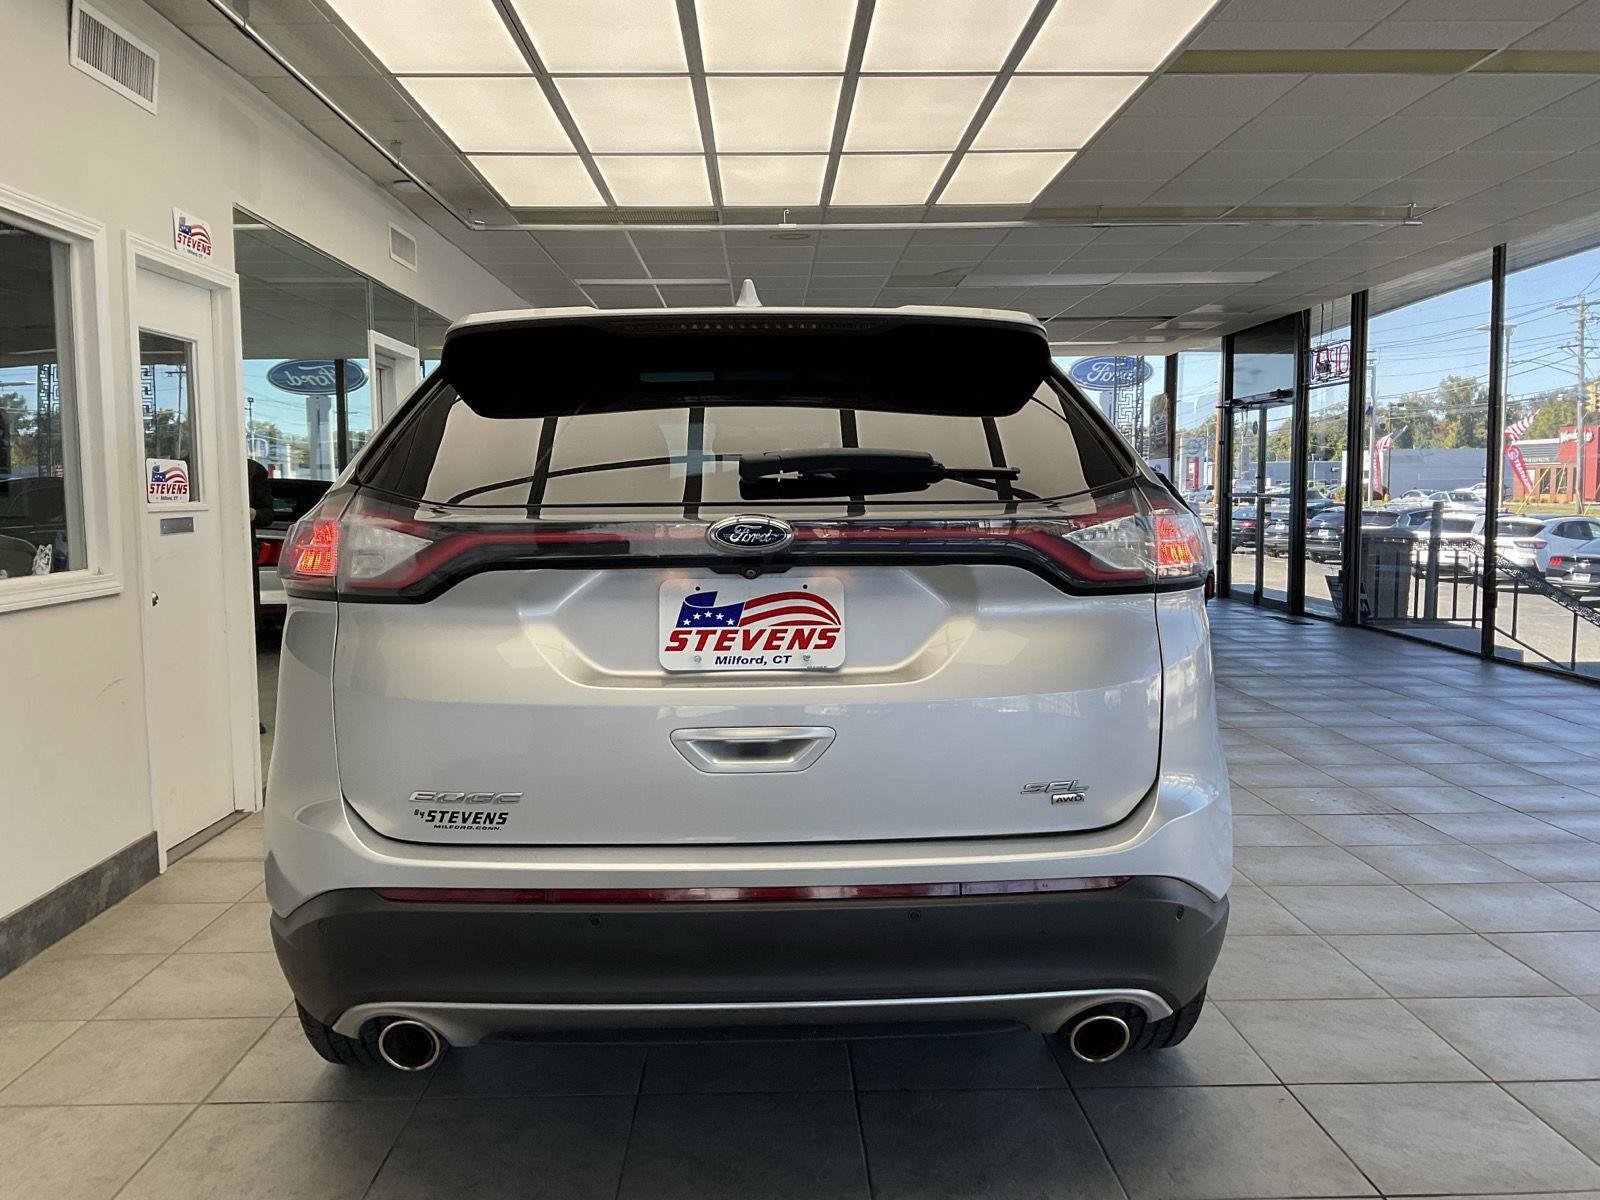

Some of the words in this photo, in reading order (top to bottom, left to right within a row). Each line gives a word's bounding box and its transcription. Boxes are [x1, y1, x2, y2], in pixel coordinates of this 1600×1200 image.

[177, 233, 212, 256] STEVENS
[149, 483, 188, 494] STEVENS
[729, 525, 774, 543] Ford
[664, 628, 841, 652] STEVENS
[714, 655, 768, 666] Milford,
[772, 655, 792, 664] CT
[409, 791, 523, 803] EDGE
[1055, 795, 1084, 803] AWD
[425, 810, 509, 825] STEVENS
